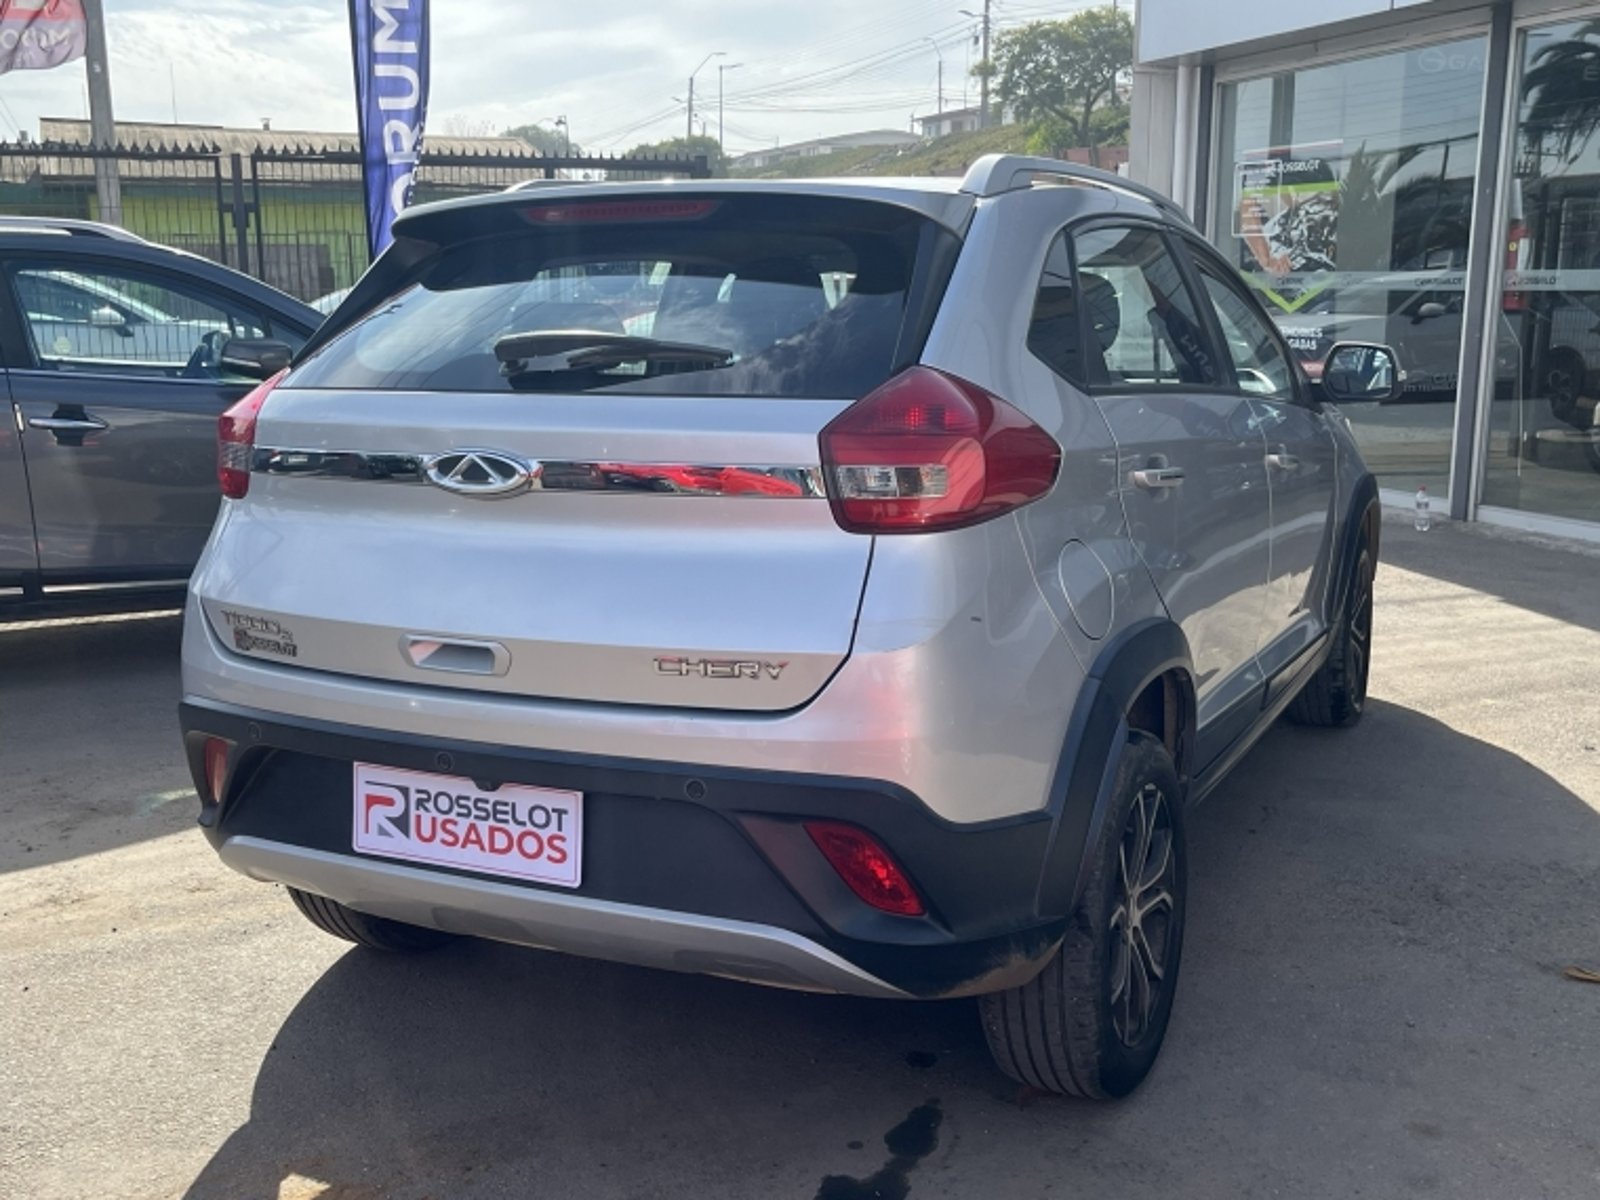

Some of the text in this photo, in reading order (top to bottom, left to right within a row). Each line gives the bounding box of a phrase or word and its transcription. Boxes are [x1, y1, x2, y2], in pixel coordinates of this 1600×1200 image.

[653, 656, 790, 680] CHERY
[415, 788, 568, 832] ROSSELOT
[415, 814, 568, 864] USADOS
